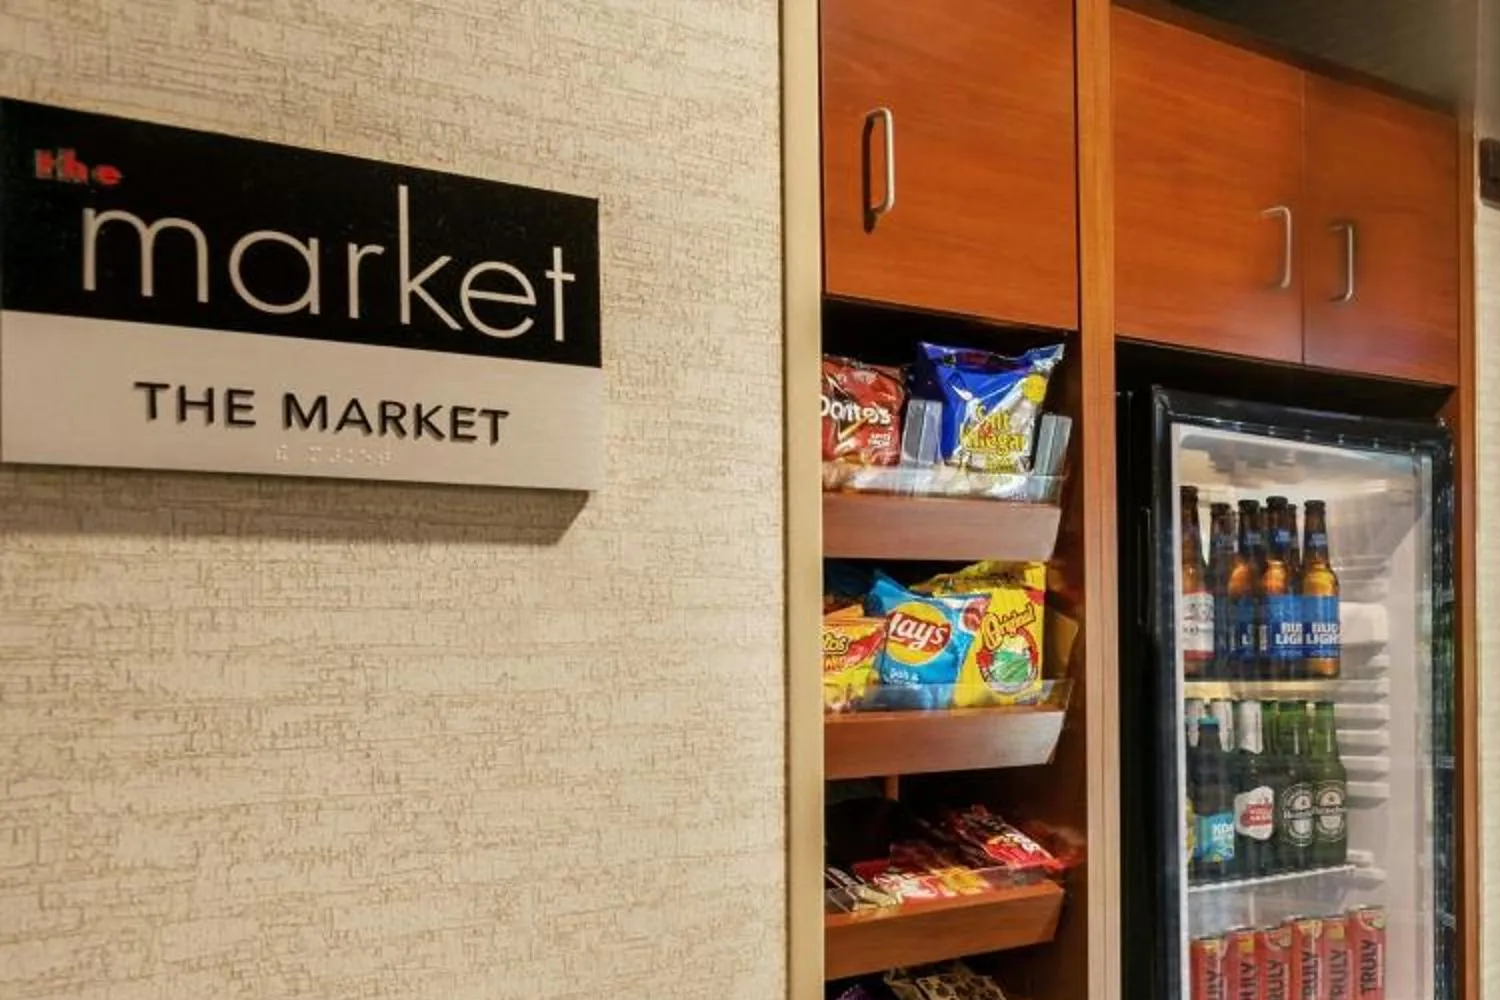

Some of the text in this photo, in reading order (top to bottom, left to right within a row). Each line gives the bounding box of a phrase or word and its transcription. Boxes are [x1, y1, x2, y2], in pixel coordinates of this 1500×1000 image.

[34, 149, 122, 186] the
[82, 184, 577, 342] market
[133, 381, 510, 445] THE MARKET
[1360, 939, 1378, 996] TRULY
